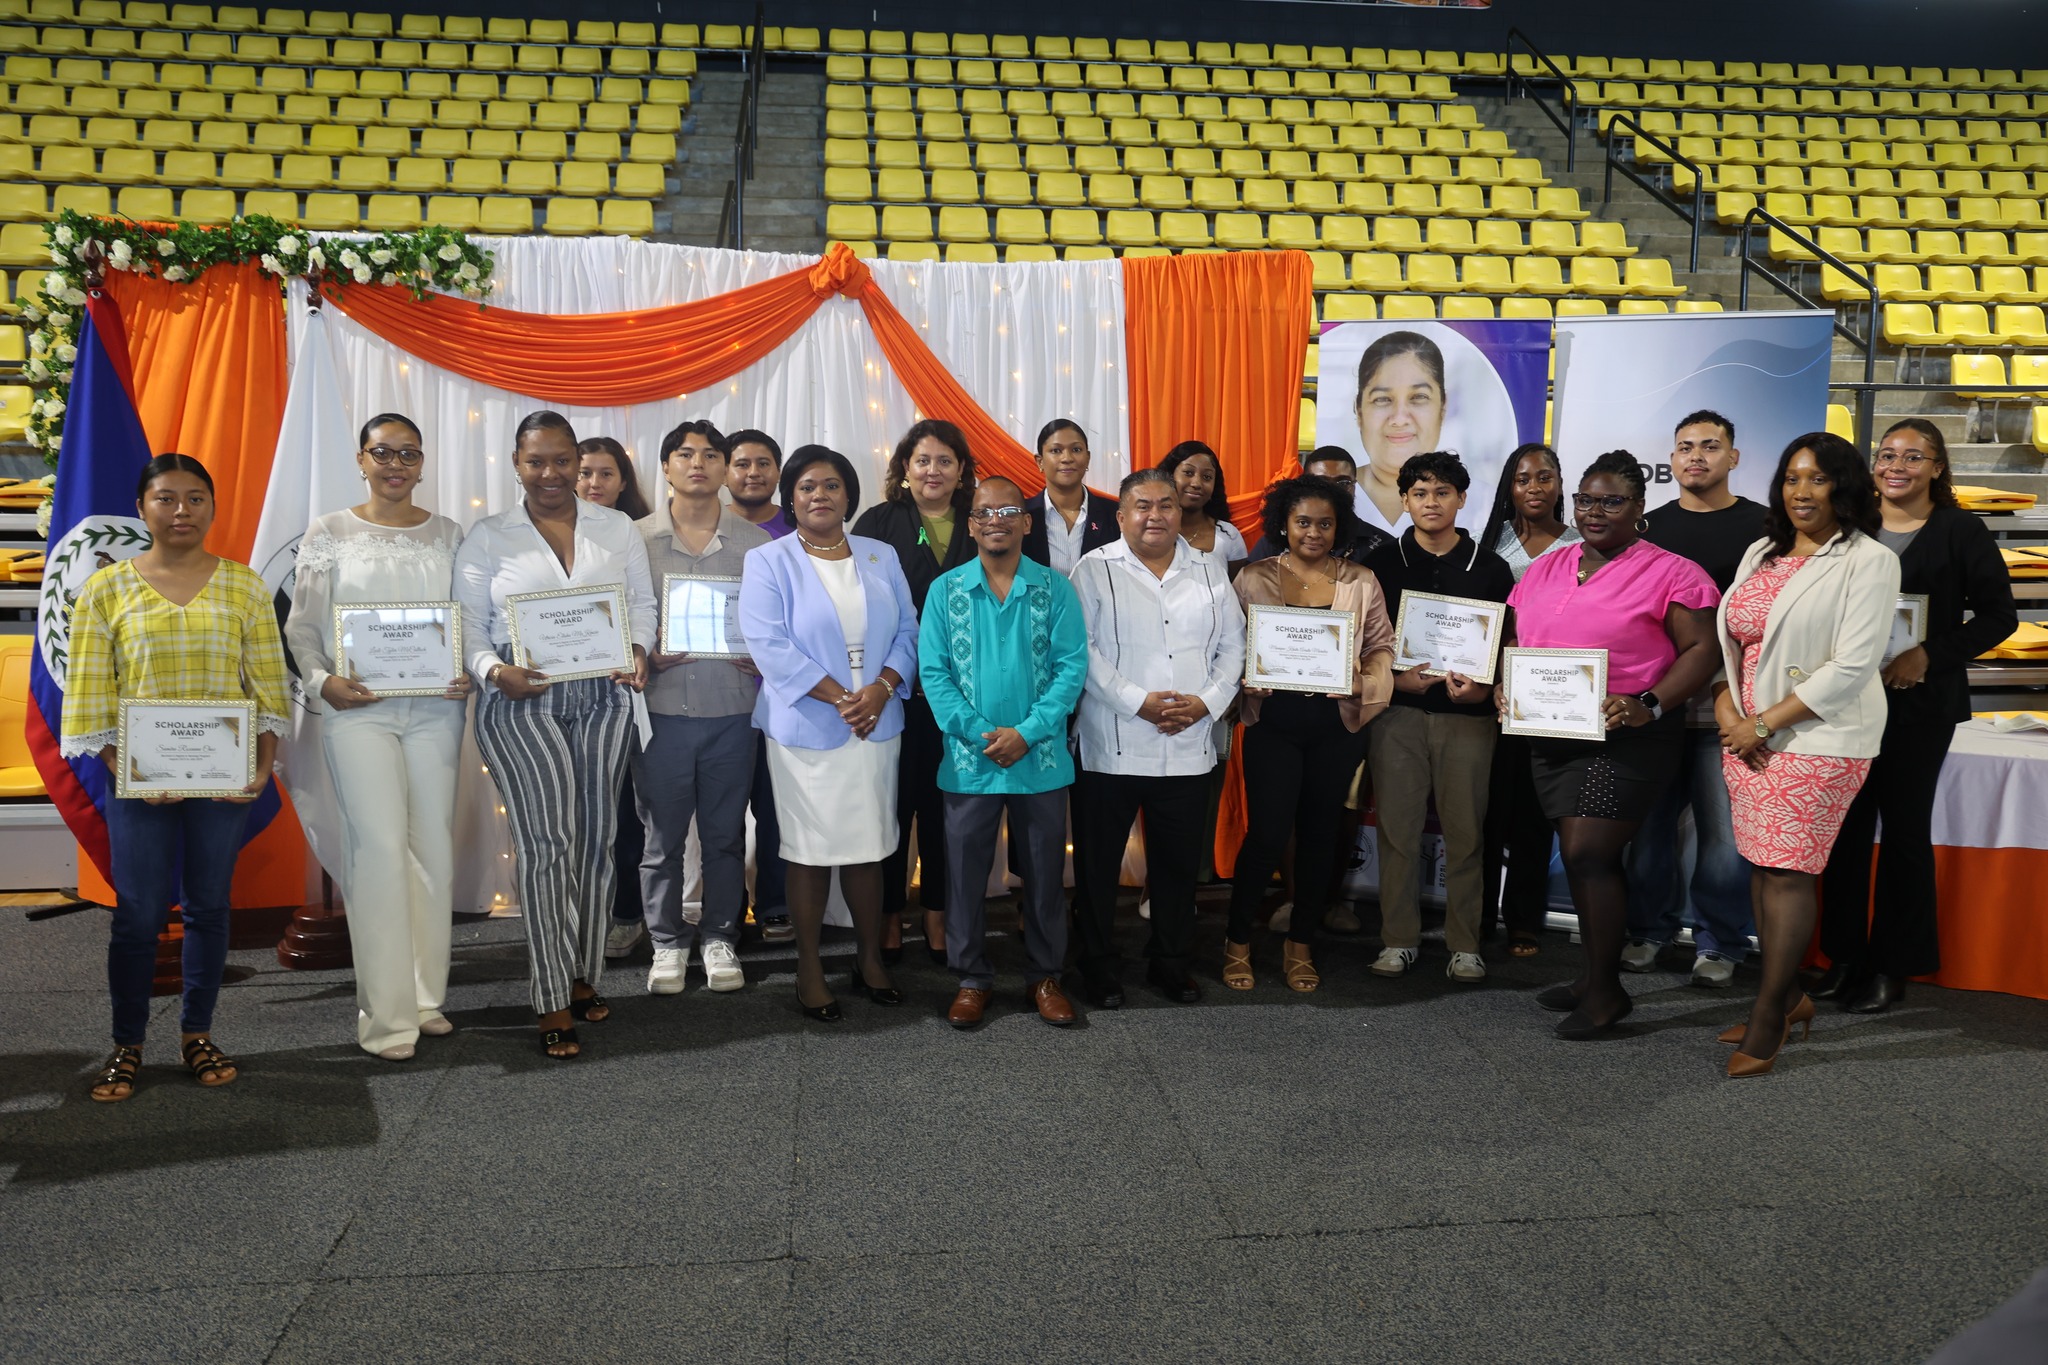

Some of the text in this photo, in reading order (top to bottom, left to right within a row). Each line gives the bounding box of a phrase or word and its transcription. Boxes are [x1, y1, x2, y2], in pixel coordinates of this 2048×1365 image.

[539, 607, 595, 620] SCHOLARSHIP
[1425, 611, 1475, 624] SCHOLARSHIP
[553, 615, 583, 625] AWARD
[1435, 619, 1462, 629] AWARD
[368, 624, 428, 632] SCHOLARSHIP
[1275, 625, 1325, 635] SCHOLARSHIP
[1530, 668, 1579, 676] SCHOLARSHIP
[154, 721, 220, 729] SCHOLARSHIP
[170, 729, 205, 737] AWARD
